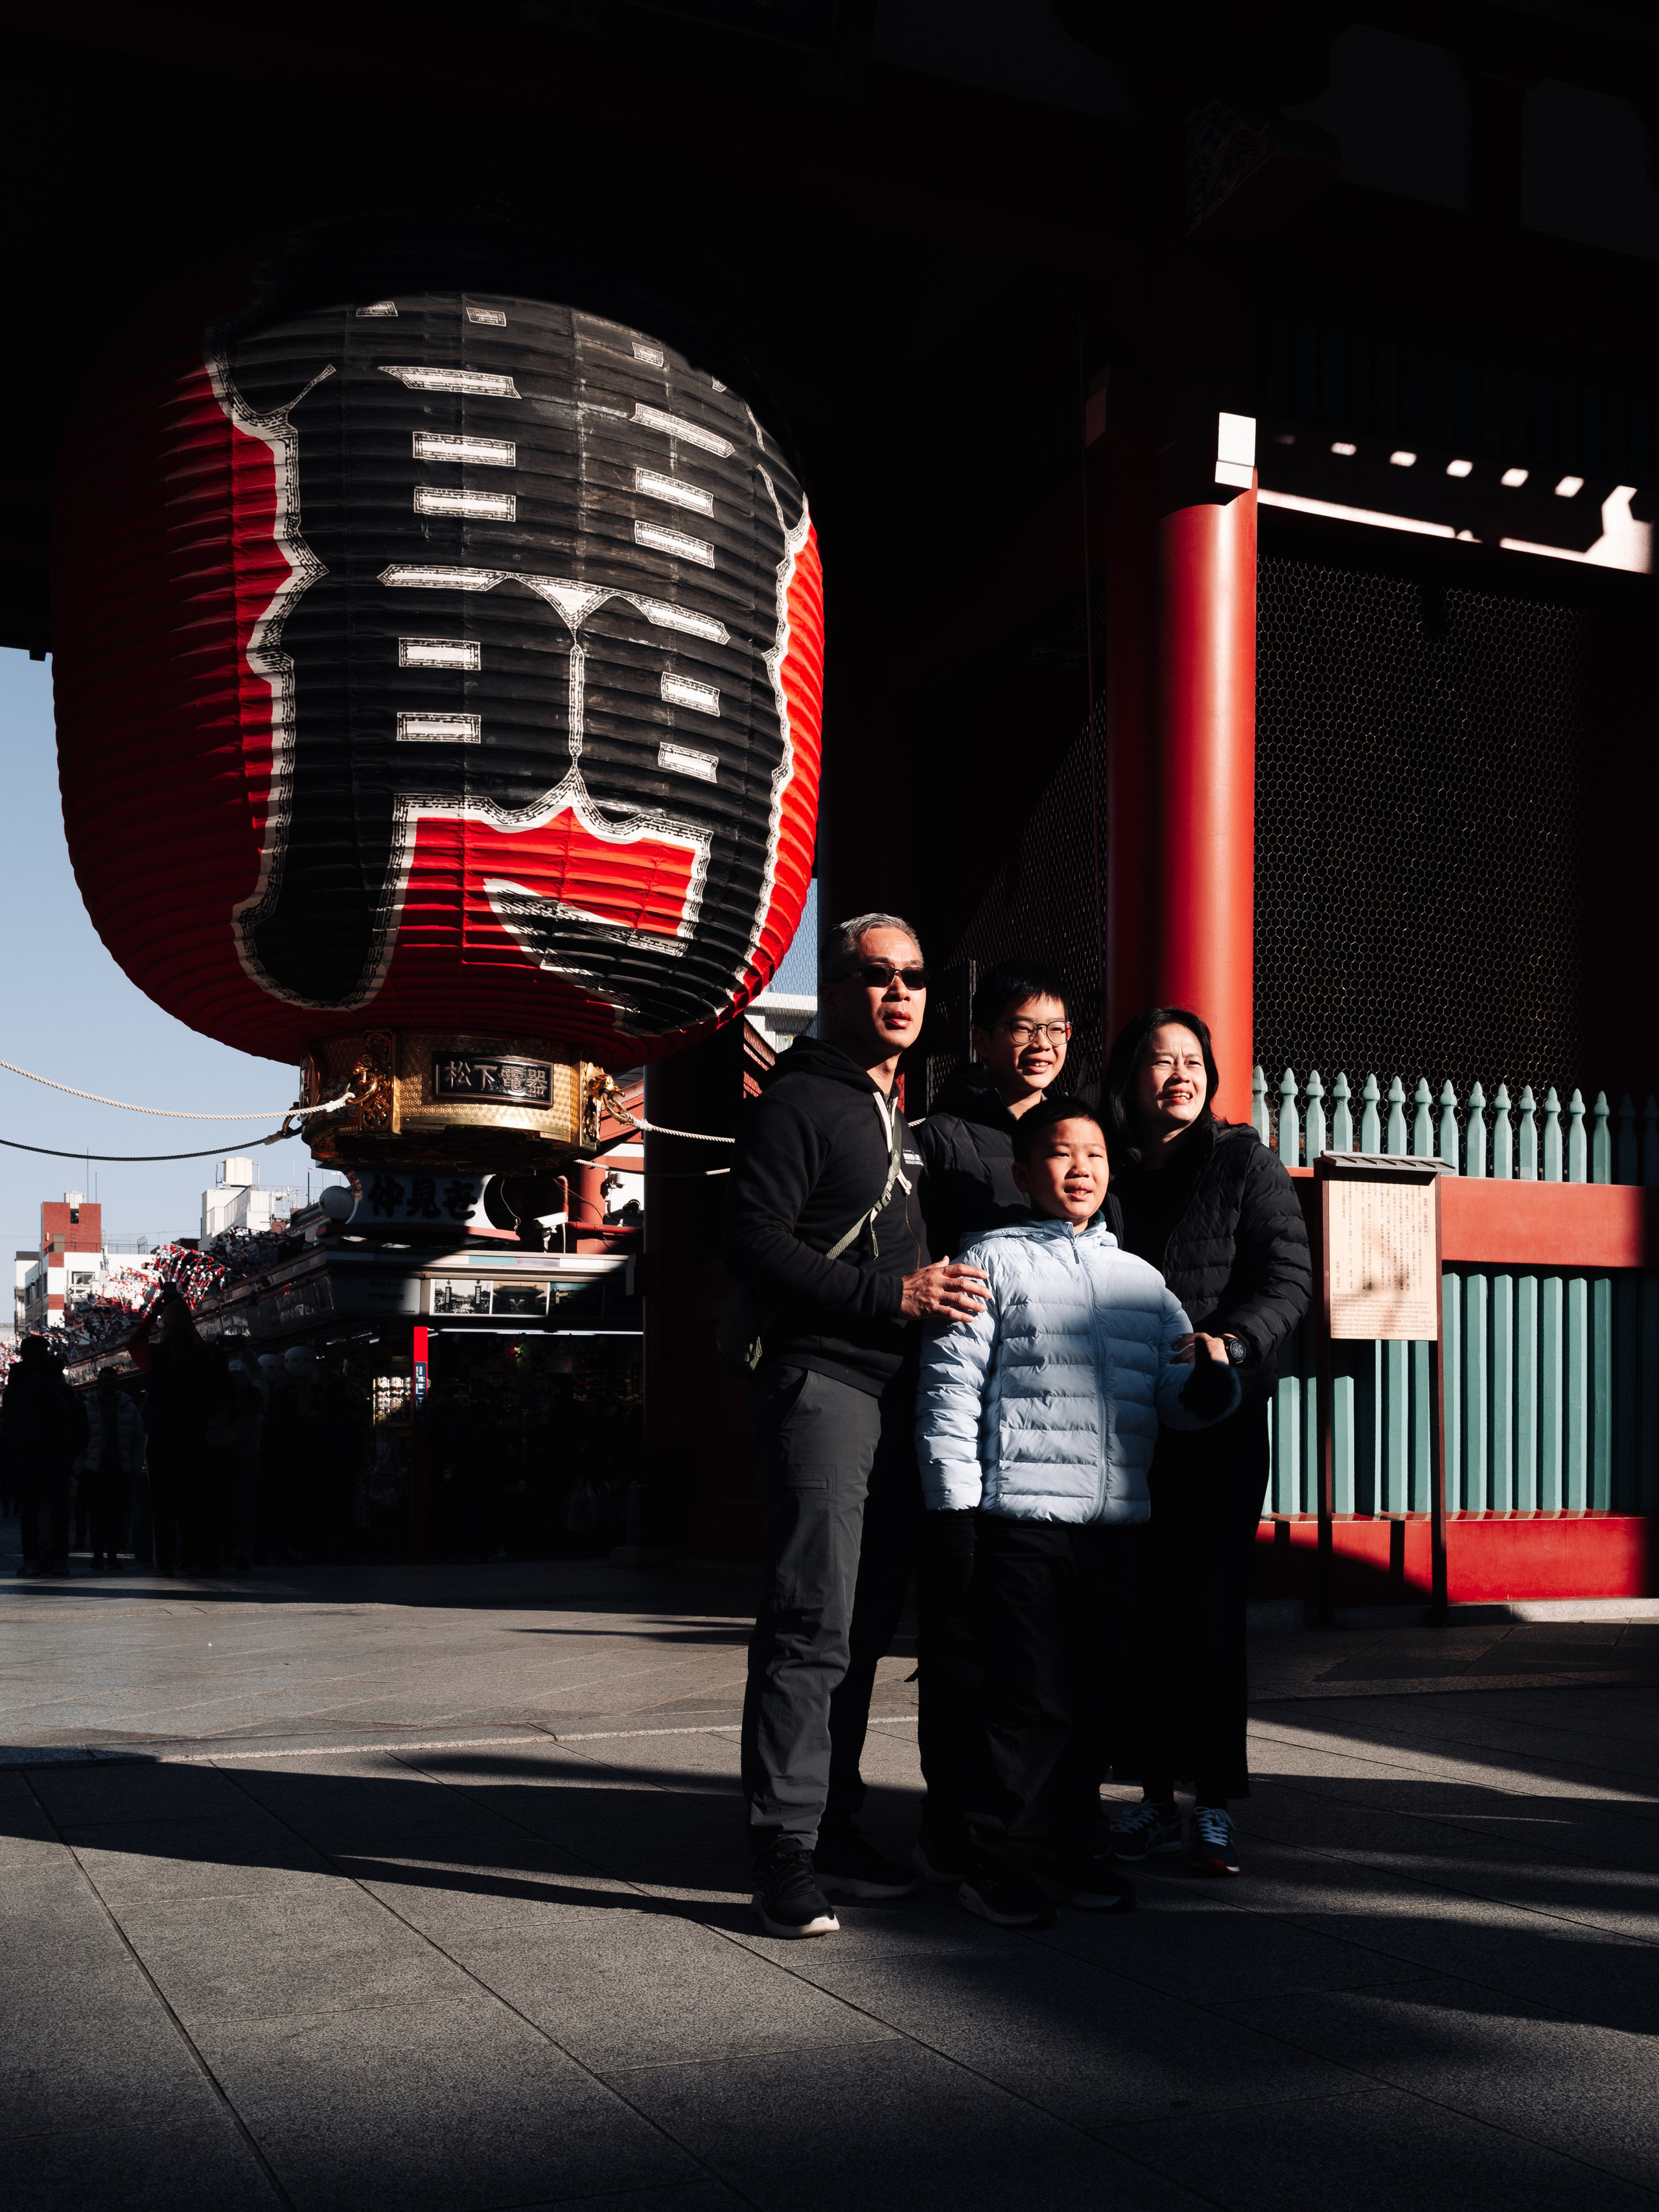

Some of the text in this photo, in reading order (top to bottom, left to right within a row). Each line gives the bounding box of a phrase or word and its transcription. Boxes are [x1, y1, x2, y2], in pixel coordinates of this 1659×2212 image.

[443, 1060, 548, 1097] 松下電器
[368, 1174, 478, 1220] 仲見世
